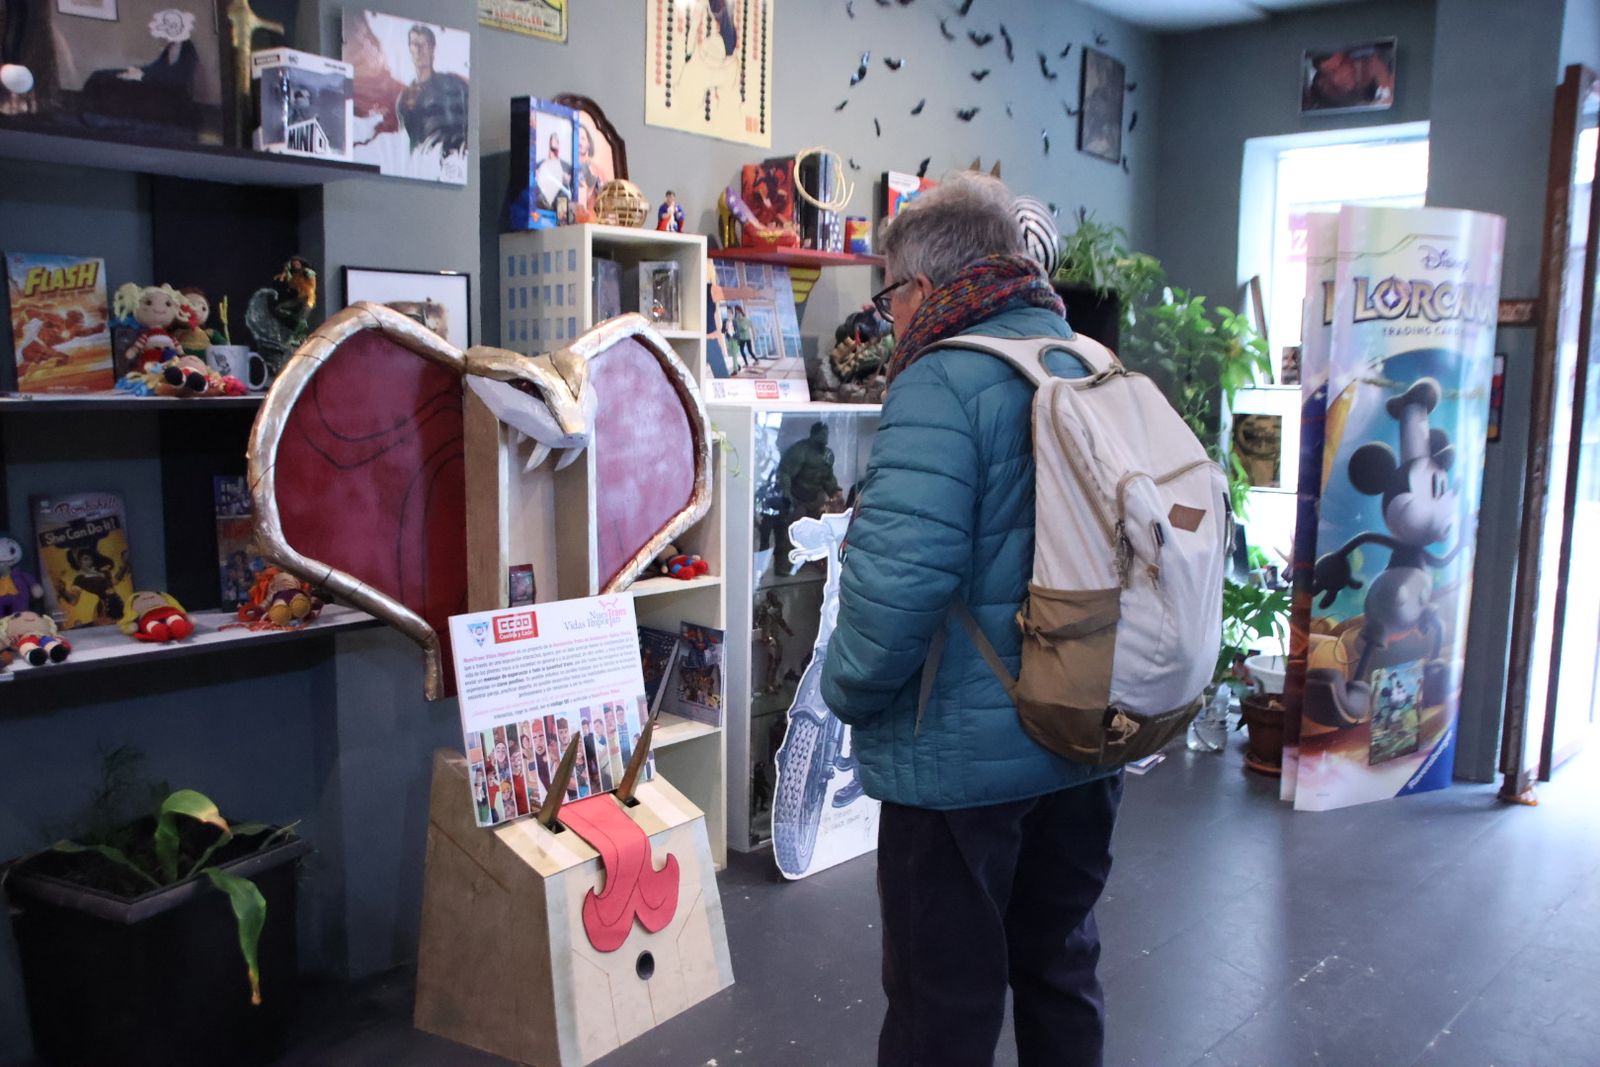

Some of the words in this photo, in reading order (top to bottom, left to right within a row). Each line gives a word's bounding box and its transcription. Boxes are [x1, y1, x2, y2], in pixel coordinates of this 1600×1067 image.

[25, 262, 98, 297] FLASH
[44, 533, 67, 546] She
[66, 527, 87, 540] Can
[87, 523, 103, 535] Do
[500, 617, 529, 630] CCOO
[564, 618, 586, 631] Vidas
